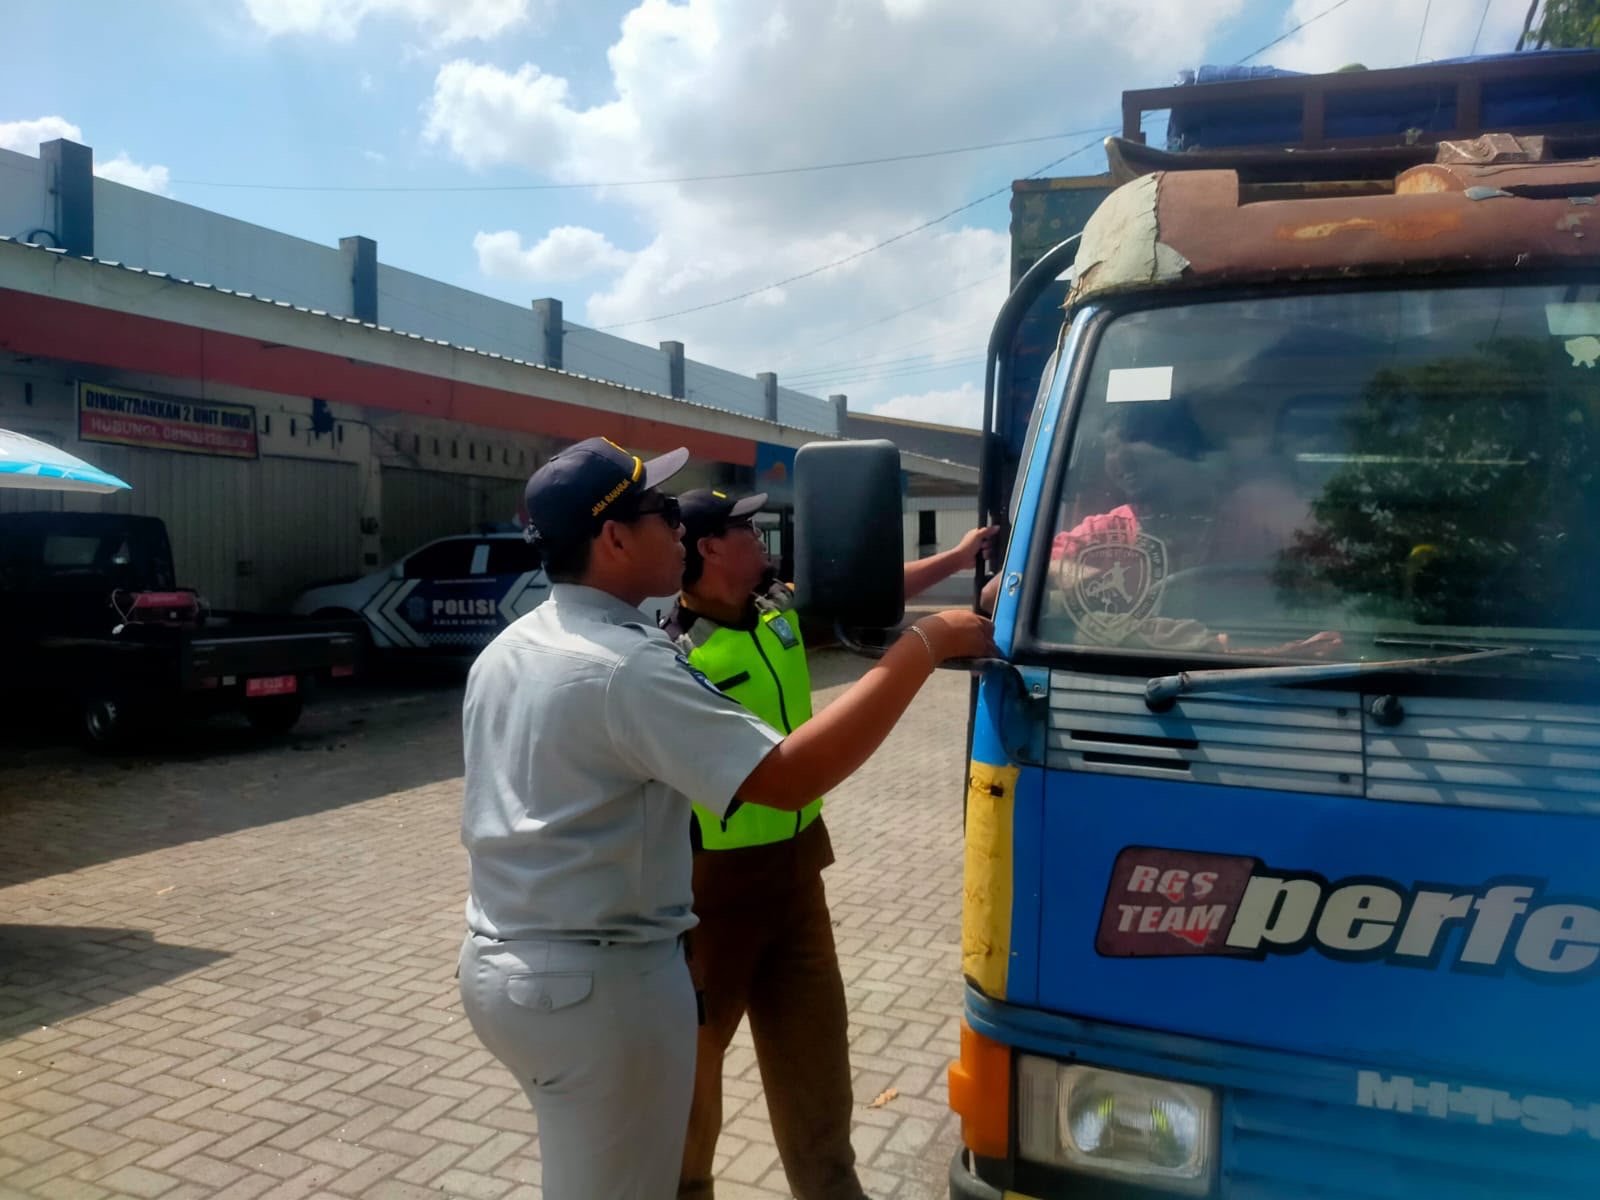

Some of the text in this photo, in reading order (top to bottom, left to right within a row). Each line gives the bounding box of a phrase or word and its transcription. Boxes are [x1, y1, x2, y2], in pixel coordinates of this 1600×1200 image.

[86, 390, 181, 419] DIKONTRAKKAN
[184, 407, 191, 422] 2
[193, 408, 219, 425] UNIT
[432, 599, 496, 615] POLISI
[1126, 864, 1219, 896] RGS
[1117, 903, 1226, 934] TEAM
[1225, 874, 1600, 974] perfe
